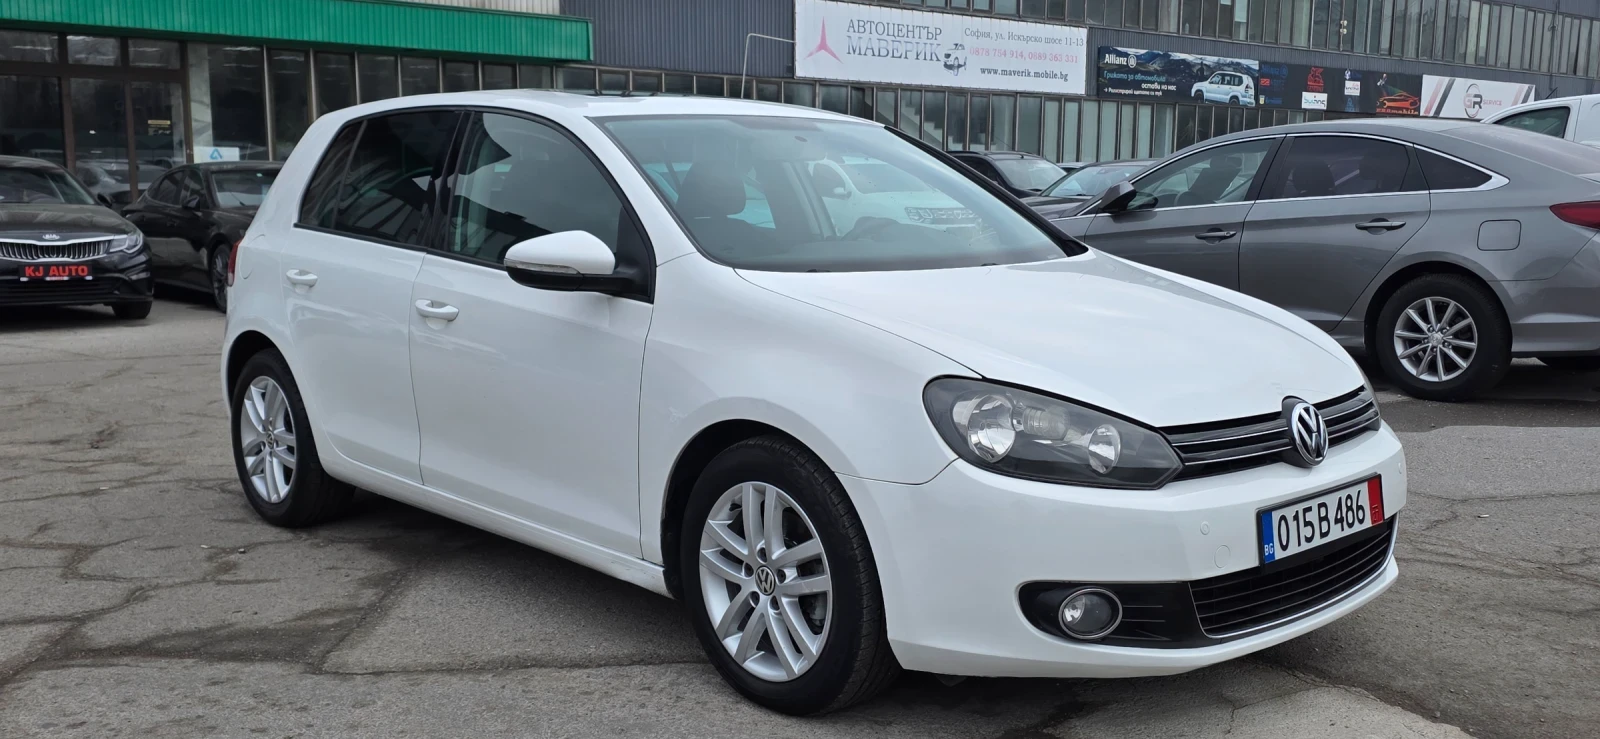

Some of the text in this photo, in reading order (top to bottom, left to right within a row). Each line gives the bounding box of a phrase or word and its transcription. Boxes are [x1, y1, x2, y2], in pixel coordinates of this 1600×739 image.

[846, 19, 942, 40] АВТОЦЕНТЪР
[964, 28, 993, 39] София,
[1008, 32, 1043, 45] Искърско
[1044, 37, 1062, 45] шосе
[1065, 37, 1084, 46] 11-13
[846, 36, 941, 61] МАВЕРИК
[969, 47, 990, 57] 0878
[992, 48, 1007, 58] 754
[1104, 54, 1127, 65] Allianz
[980, 67, 1069, 82] www.maverik.mobile.bg
[1463, 93, 1483, 109] GR
[25, 265, 88, 276] KJ AUTO
[1264, 543, 1274, 556] BG
